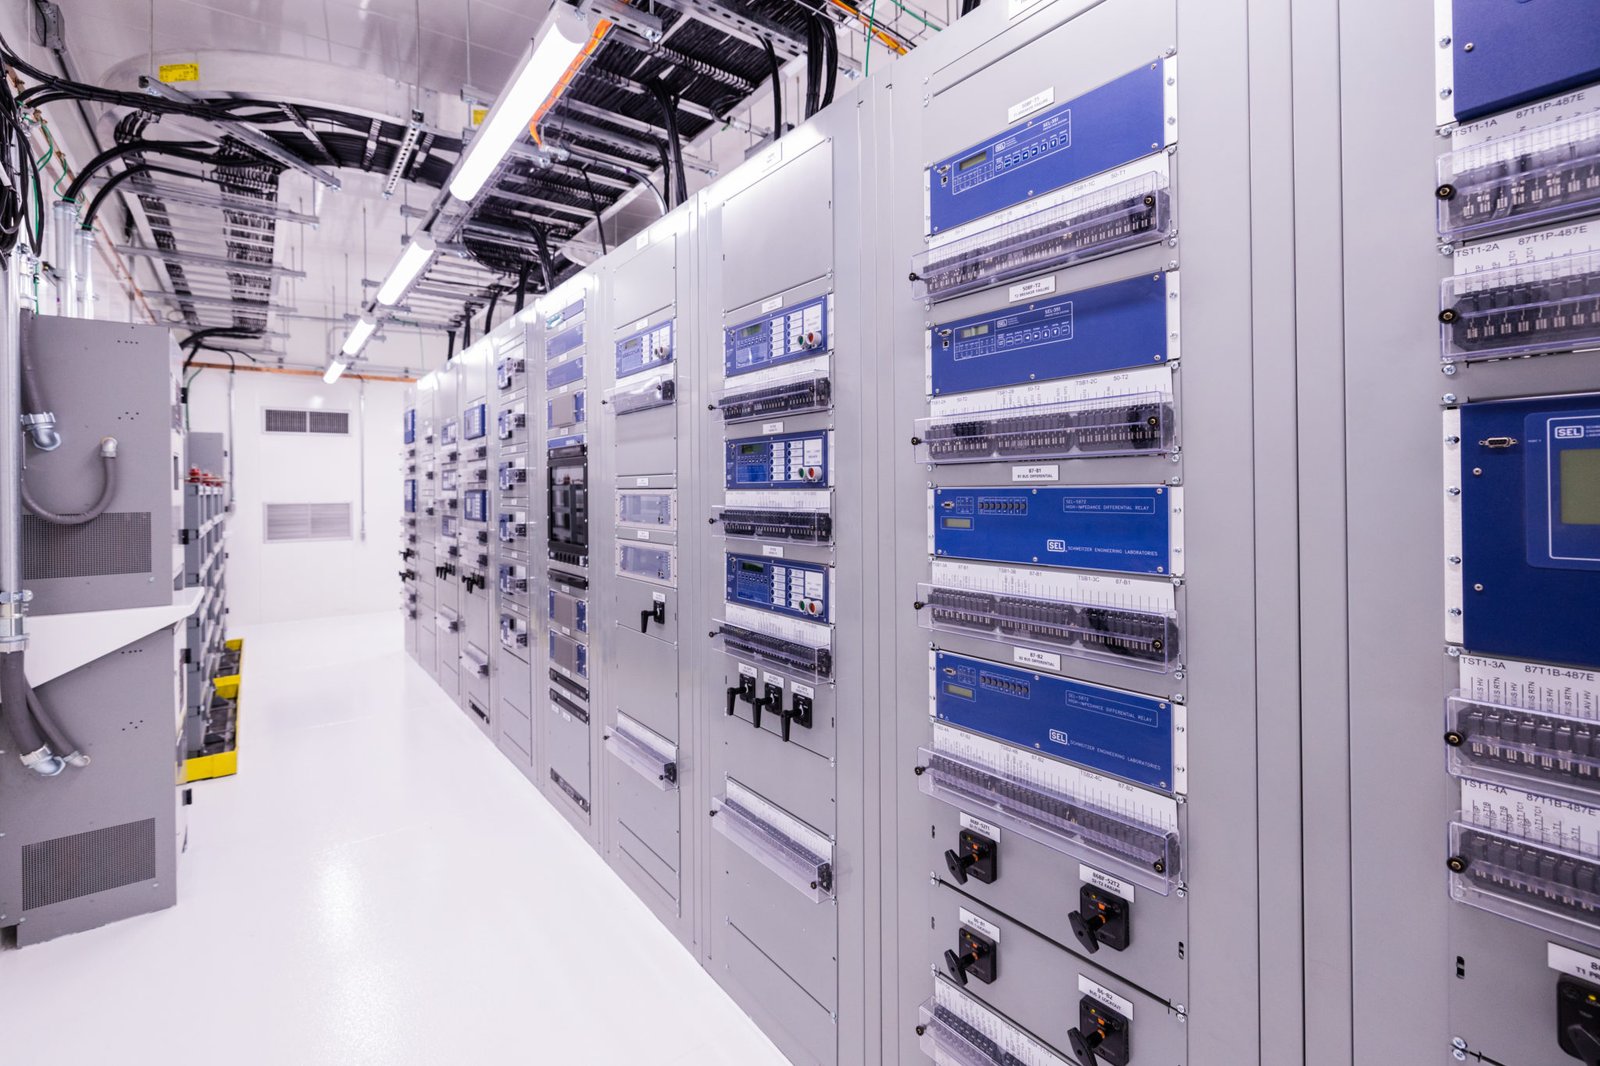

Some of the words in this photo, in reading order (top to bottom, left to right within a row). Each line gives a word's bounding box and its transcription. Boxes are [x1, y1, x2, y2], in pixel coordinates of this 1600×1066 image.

[1516, 92, 1585, 119] 87T1P-487E
[1454, 119, 1498, 136] TST1-1A
[1518, 225, 1588, 246] 87T1P-487E
[1456, 243, 1500, 258] TST1-2A
[1558, 428, 1580, 437] SEL
[1049, 541, 1063, 550] SEL
[1124, 549, 1158, 557] LABORATORIES
[1462, 657, 1506, 670] TST1-3A
[1524, 664, 1595, 681] 87T1B-487E
[1051, 731, 1066, 742] SEL
[1127, 756, 1161, 770] LABORATORIES
[1575, 965, 1586, 975] T1
